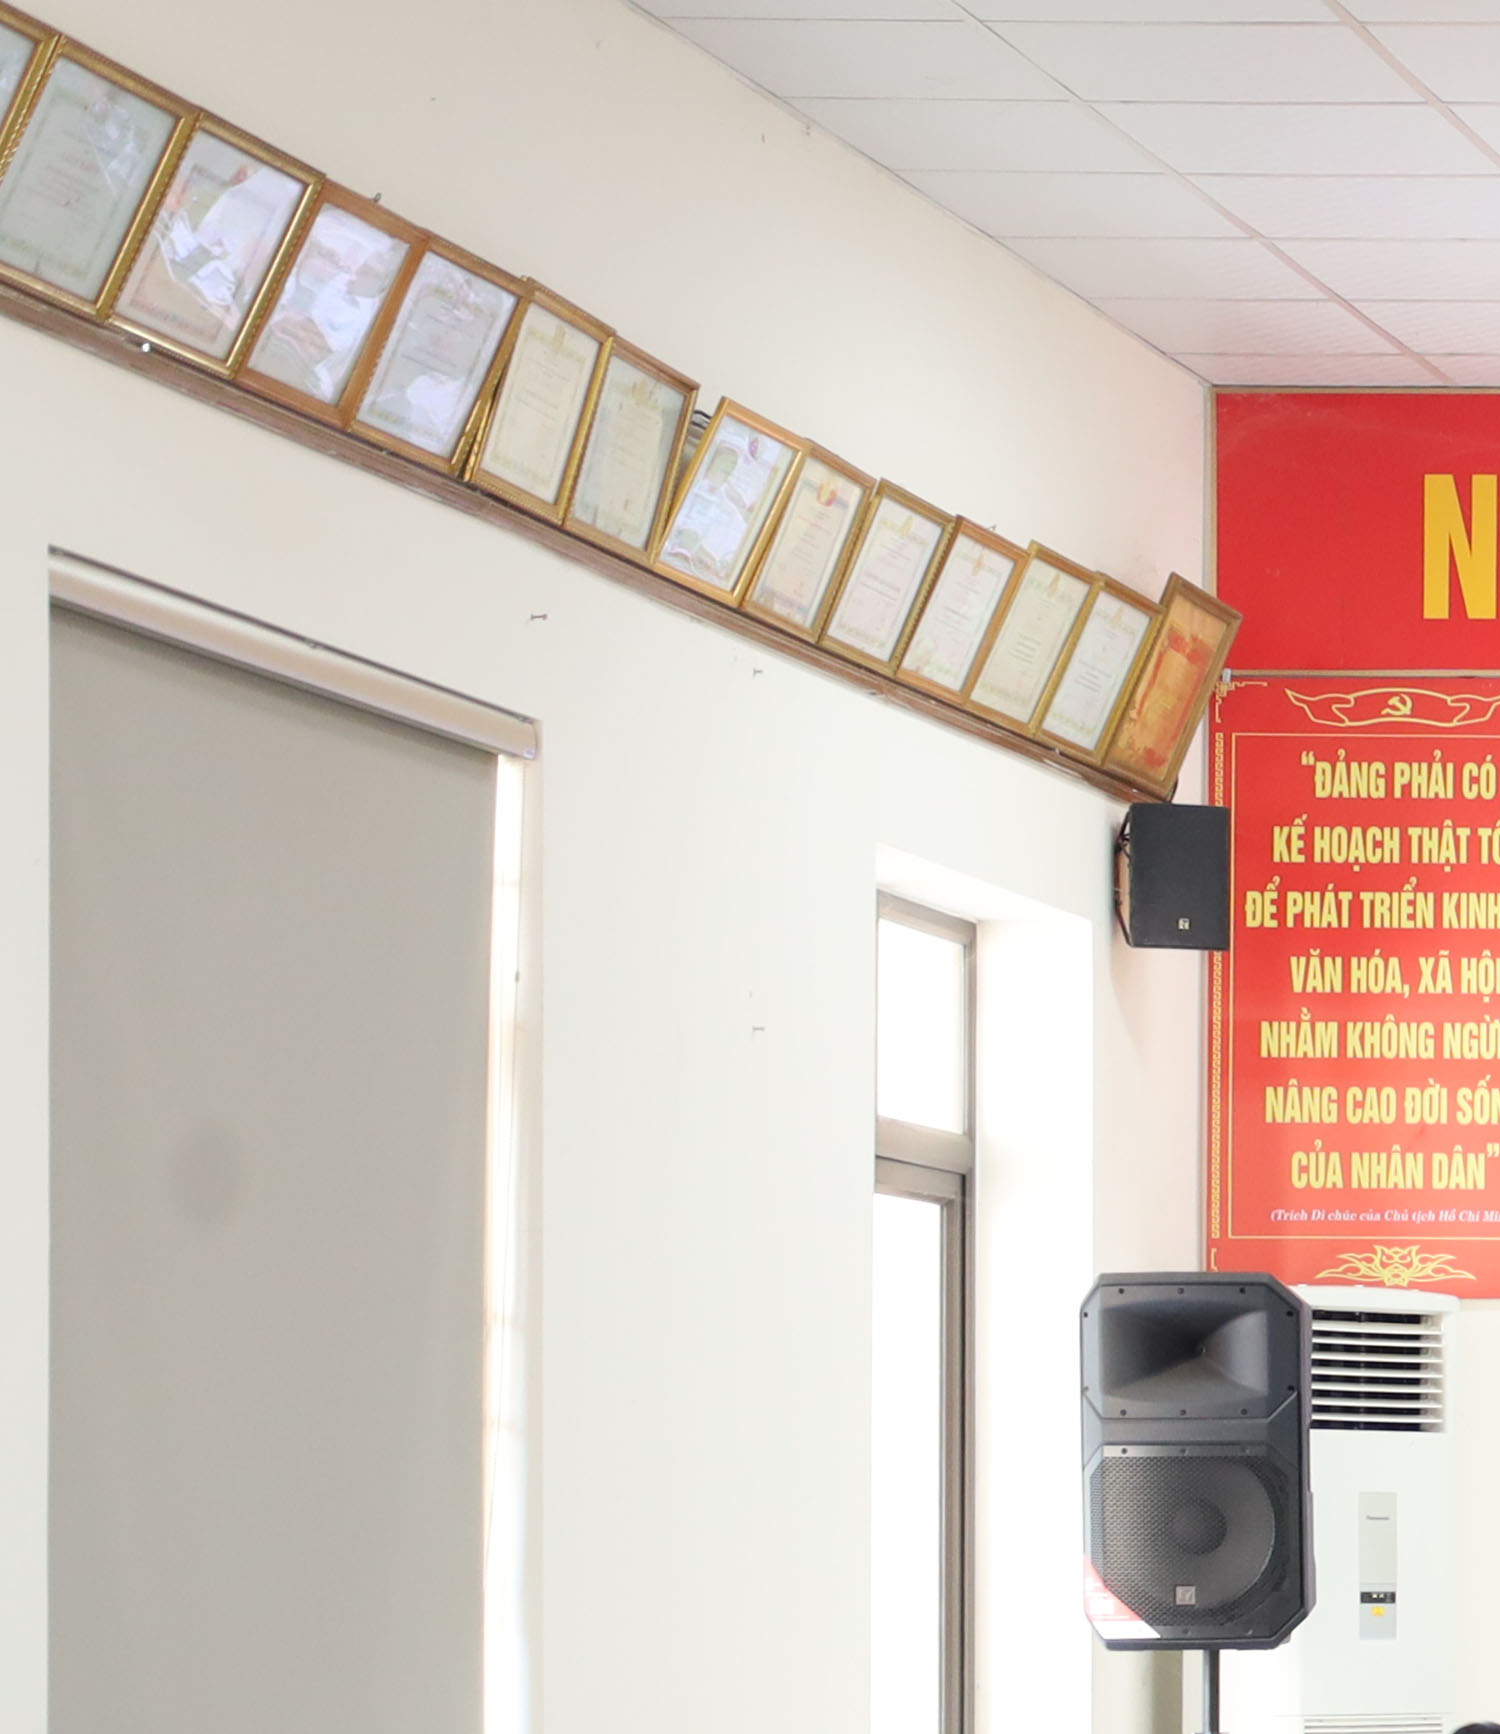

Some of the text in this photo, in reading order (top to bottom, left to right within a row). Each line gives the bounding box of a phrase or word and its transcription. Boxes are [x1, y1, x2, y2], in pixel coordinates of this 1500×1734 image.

[1301, 748, 1497, 800] “ĐẢNG PHẢI CÓ
[1273, 814, 1308, 863] KẾ
[1313, 825, 1401, 872] HOẠCH
[1407, 819, 1471, 873] THẬT
[1244, 876, 1281, 928] ĐỂ
[1286, 883, 1353, 929] PHÁT
[1359, 876, 1435, 929] TRIỂN
[1290, 948, 1343, 993] VĂN
[1350, 949, 1410, 999] HÓA,
[1417, 950, 1454, 994] XÃ
[1260, 1007, 1339, 1059] NHẰM
[1346, 1013, 1435, 1060] KHÔNG
[1265, 1078, 1338, 1124] NÂNG
[1346, 1086, 1397, 1125] CAO
[1403, 1078, 1448, 1125] ĐỜI
[1291, 1139, 1500, 1190] CỦA NHÂN DÂN”
